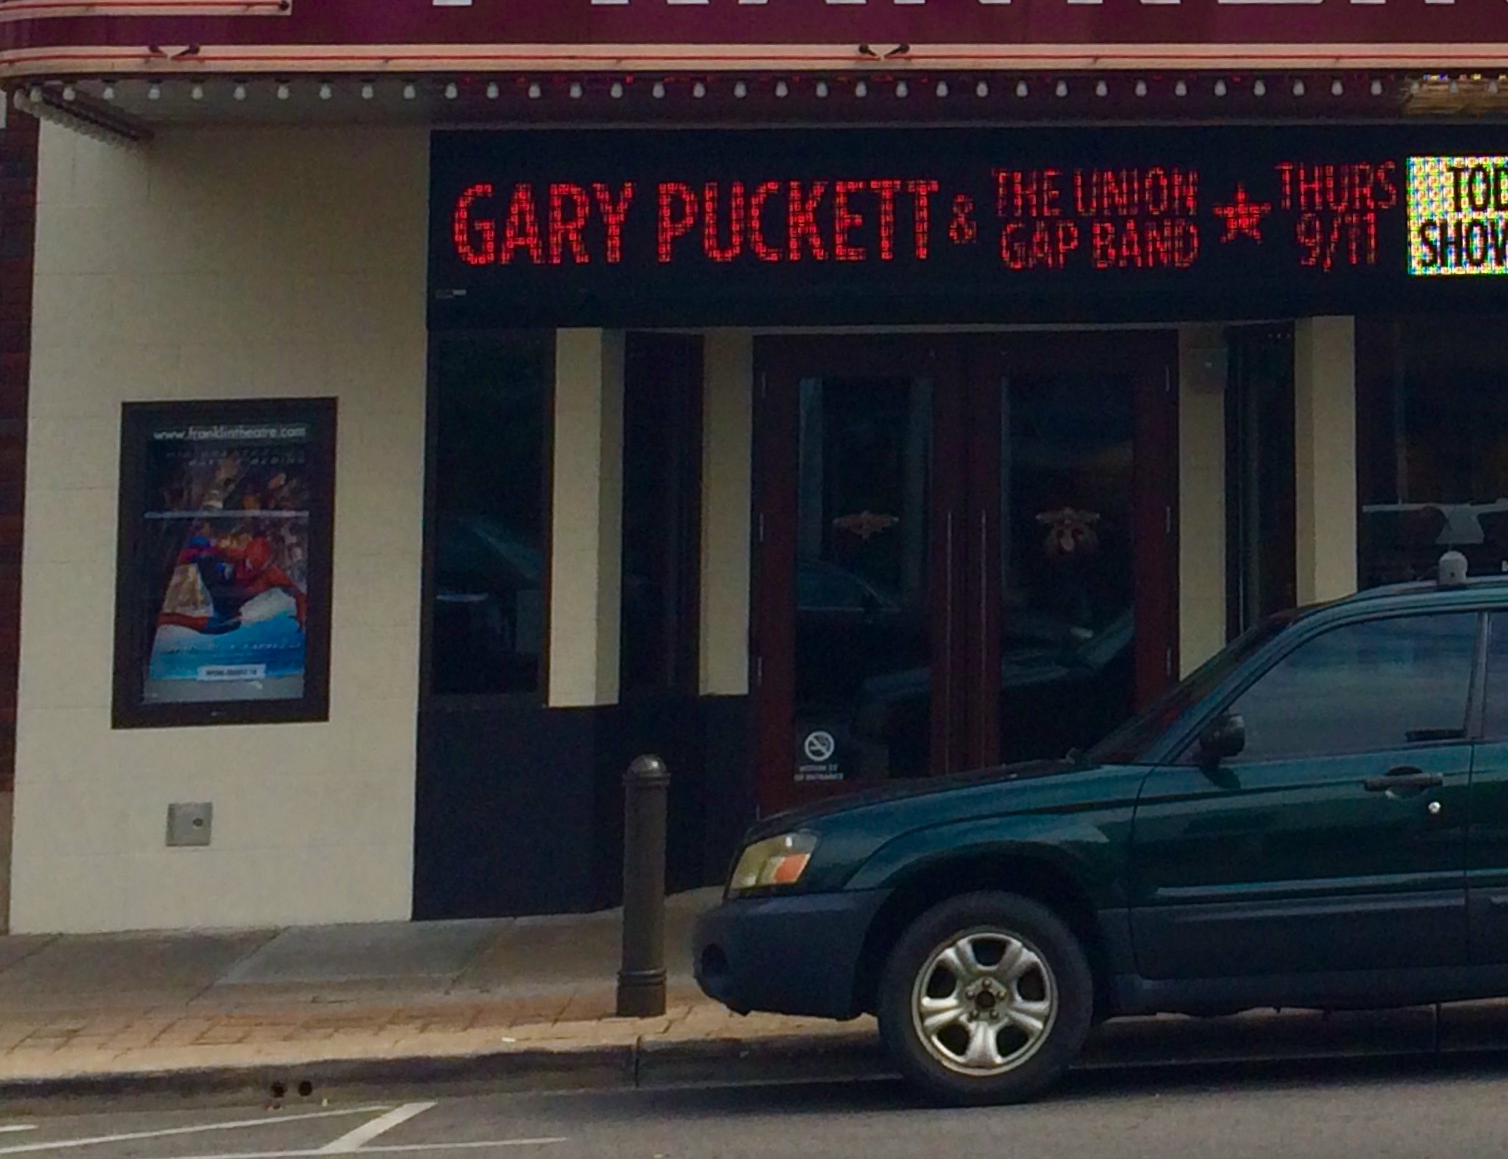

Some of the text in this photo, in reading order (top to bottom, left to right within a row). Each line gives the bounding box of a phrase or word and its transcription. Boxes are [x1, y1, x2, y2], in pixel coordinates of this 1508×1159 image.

[992, 166, 1198, 217] THE UNION
[1275, 160, 1397, 210] THURS
[453, 179, 977, 265] GARY PUCKETT &
[1001, 218, 1199, 269] GAP BAND
[1296, 212, 1377, 272] 9/11
[153, 424, 307, 441] www.franklintheatre.com
